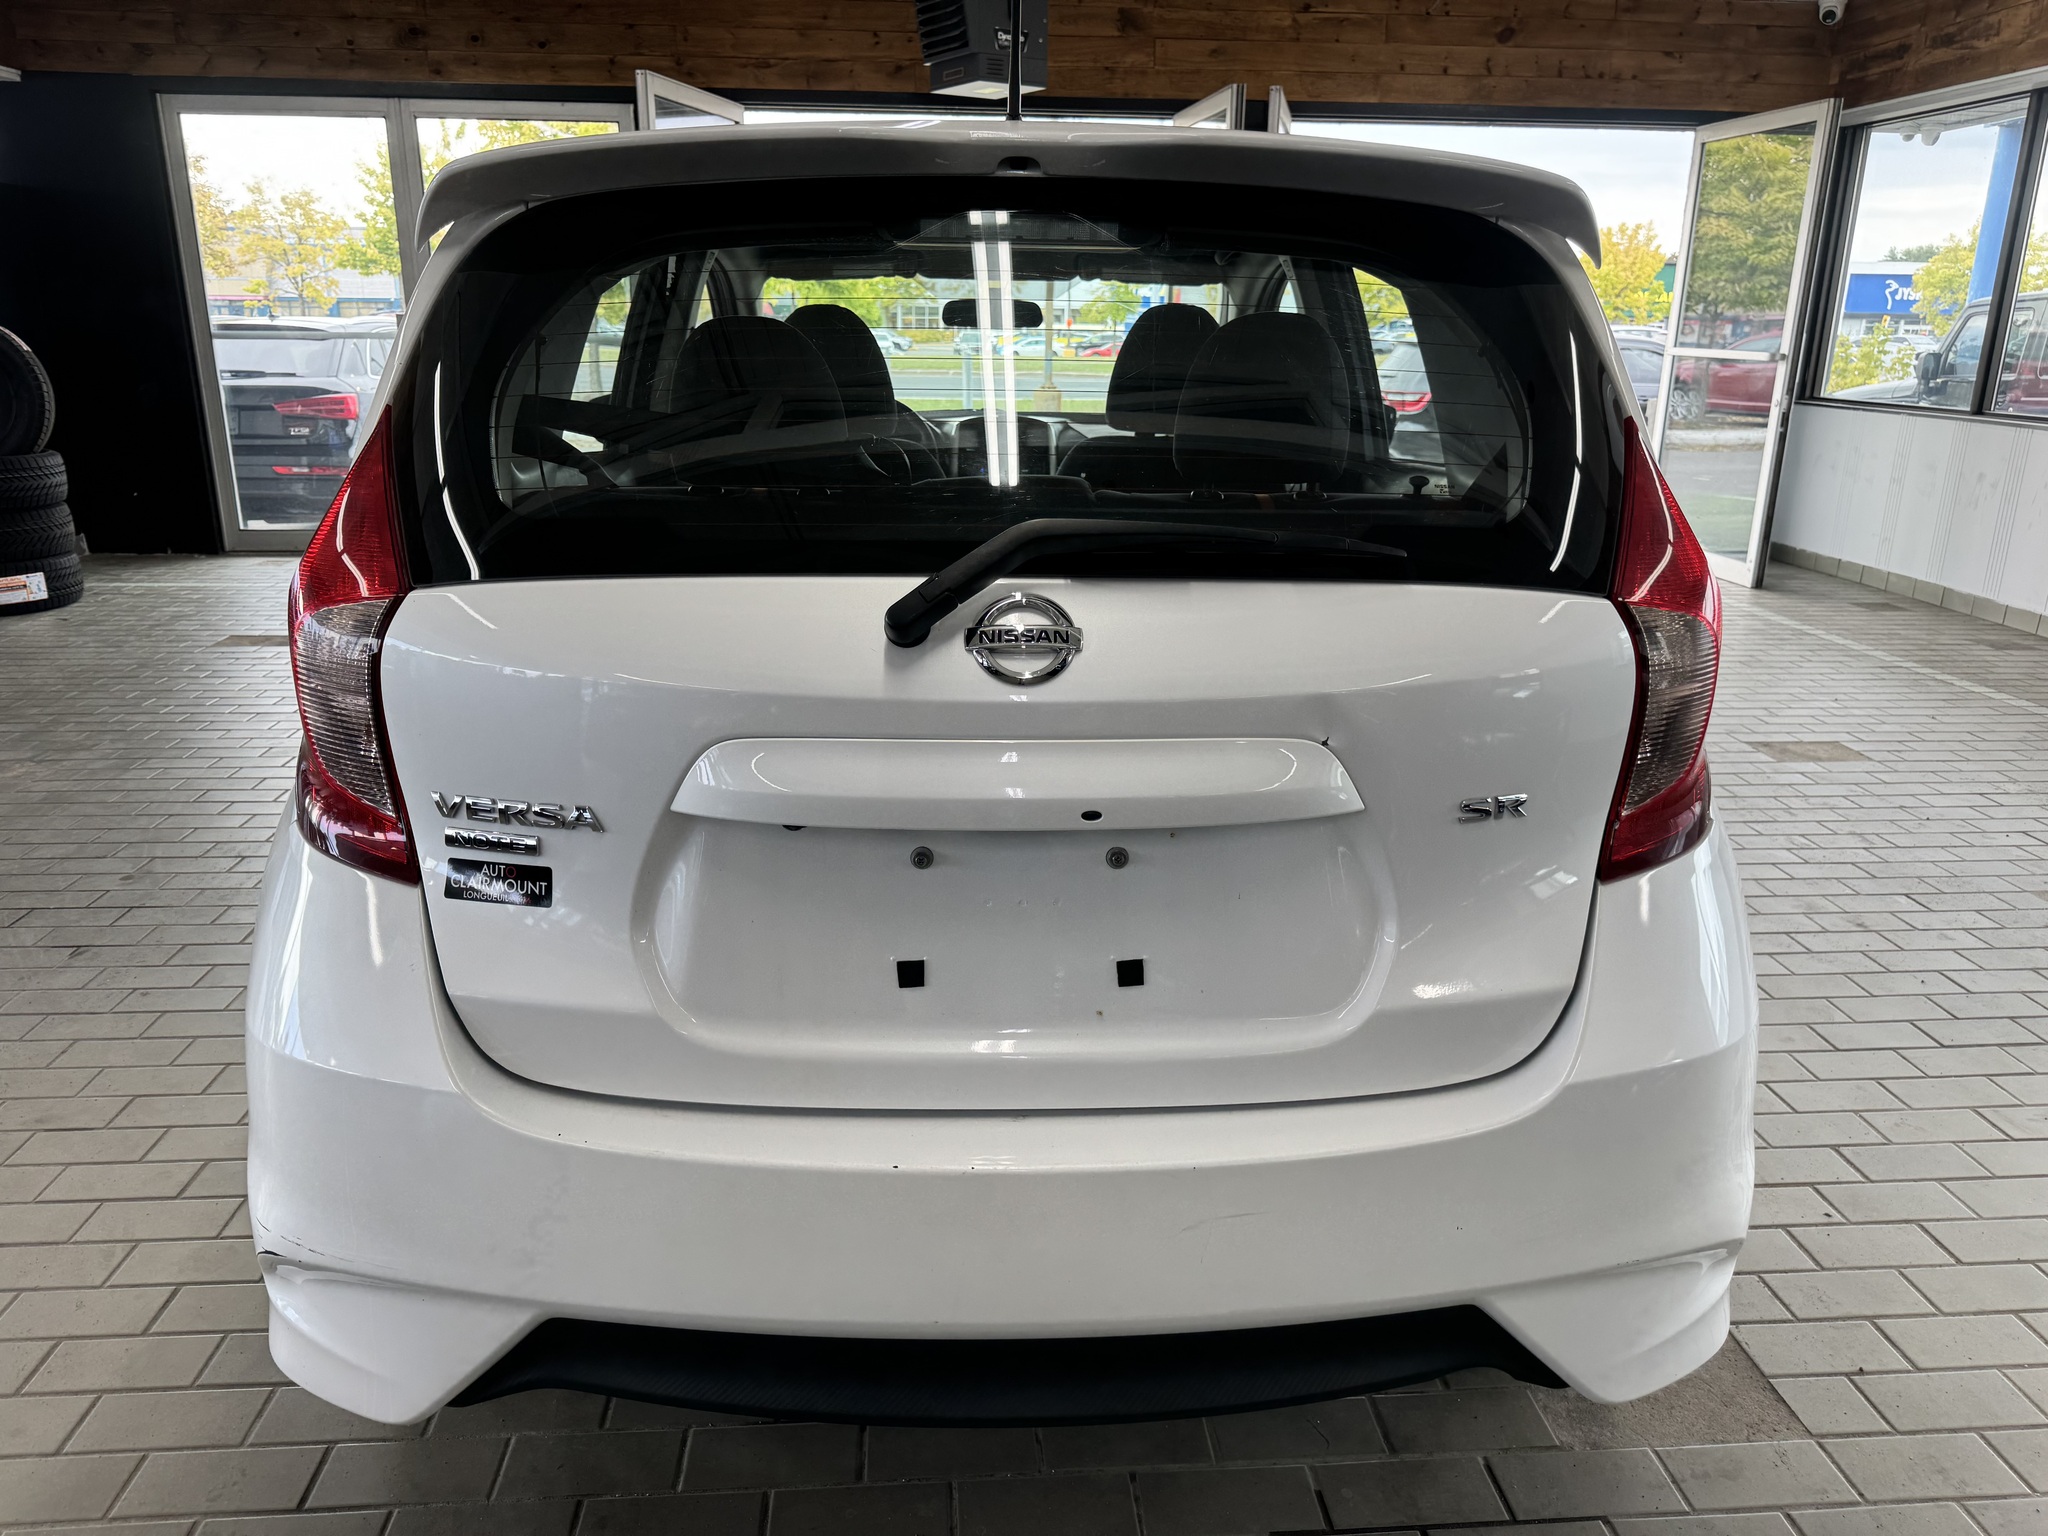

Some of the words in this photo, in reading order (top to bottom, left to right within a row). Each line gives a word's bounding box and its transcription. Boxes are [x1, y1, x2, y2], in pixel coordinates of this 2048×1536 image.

[978, 630, 1070, 644] NISSAN
[430, 790, 605, 833] VERSA
[1458, 793, 1528, 824] SR
[454, 831, 528, 854] NOTE
[480, 863, 516, 879] AUTO
[450, 875, 548, 896] CLAIRMOUNT
